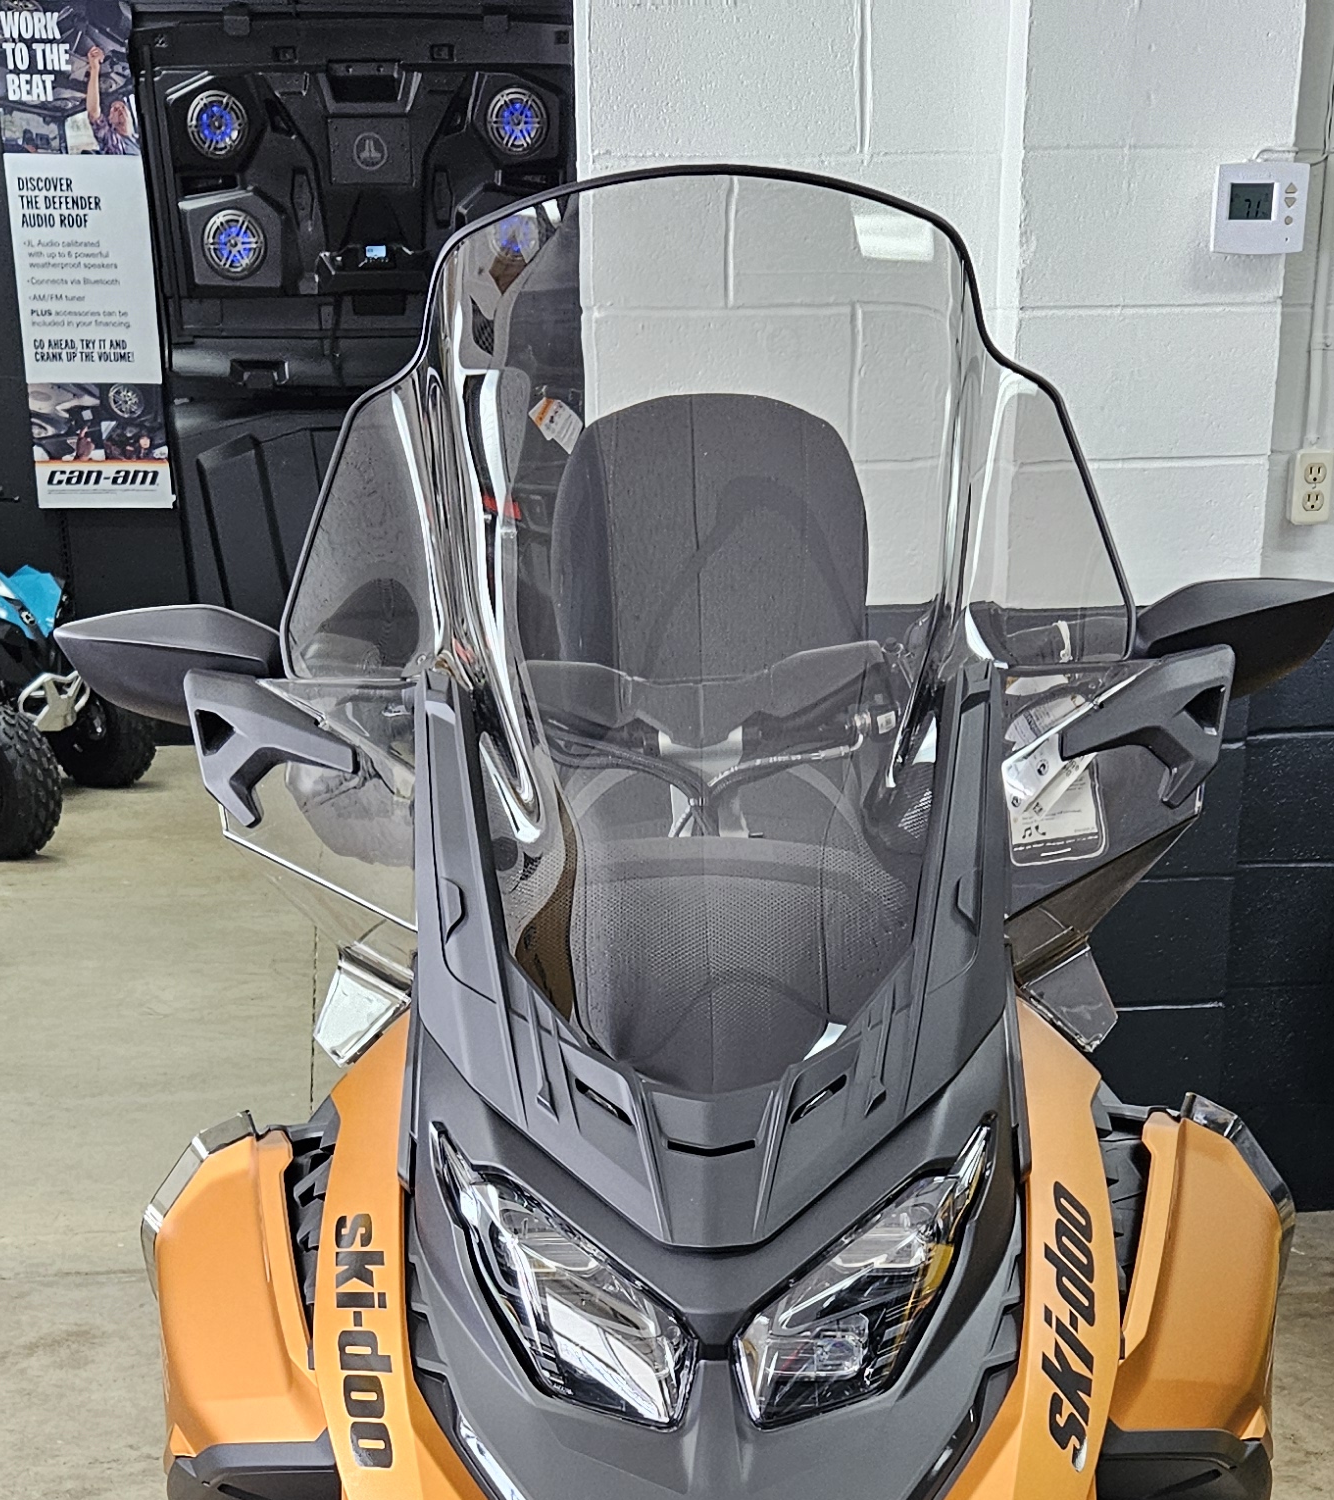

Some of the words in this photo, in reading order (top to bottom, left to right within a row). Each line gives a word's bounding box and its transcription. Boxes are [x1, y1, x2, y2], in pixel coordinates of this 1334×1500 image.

[2, 42, 30, 71] TO
[32, 43, 72, 71] THE
[6, 73, 55, 102] BEAT
[17, 176, 73, 192] DISCOVER
[18, 194, 41, 210] THE
[44, 195, 102, 211] DEFENDER
[21, 213, 56, 228] AUDIO
[59, 213, 89, 228] ROOF
[37, 239, 60, 247] Audio
[61, 239, 101, 247] calibrated
[47, 252, 57, 260] up
[75, 251, 110, 260] powerful
[83, 261, 118, 270] speakers
[31, 277, 68, 286] Connects
[70, 277, 81, 285] via
[33, 294, 63, 302] AM/FM
[31, 309, 53, 317] PLUS
[33, 339, 45, 350] GO
[48, 339, 78, 351] AHEAD,
[80, 339, 96, 350] TRY
[98, 339, 107, 350] IT
[109, 339, 127, 350] AND
[34, 351, 64, 363] CRANK
[66, 351, 78, 362] UP
[80, 351, 95, 362] THE
[98, 351, 135, 363] VOLUME!
[47, 469, 160, 486] can-am
[1041, 1181, 1095, 1473] ski-doo
[335, 1213, 393, 1468] ski-doo
